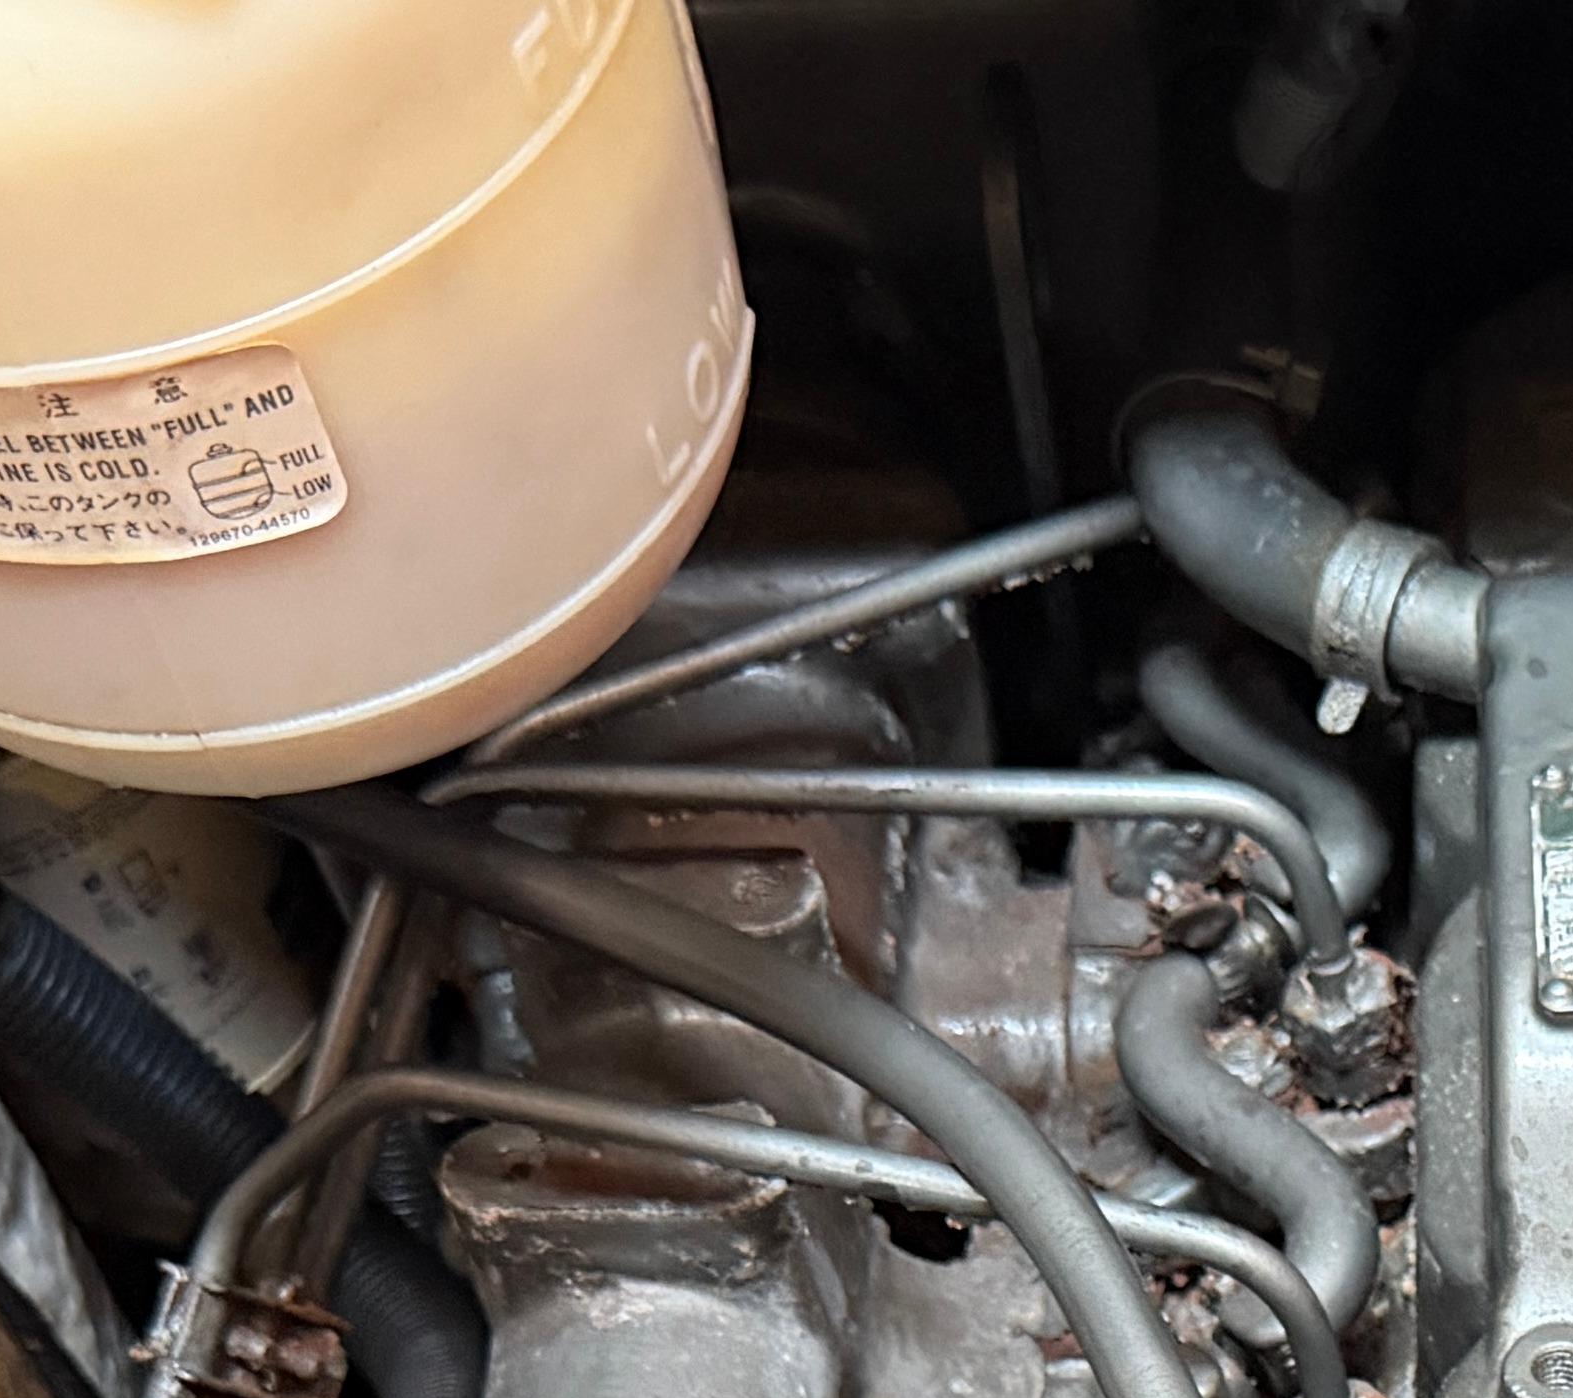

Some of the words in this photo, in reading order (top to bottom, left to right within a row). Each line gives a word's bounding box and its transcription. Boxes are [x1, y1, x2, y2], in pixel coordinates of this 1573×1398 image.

[26, 427, 147, 455] BETWEEN
[150, 403, 234, 441] "FULL"
[245, 383, 295, 419] AND
[44, 464, 74, 483] IS
[78, 456, 161, 482] COLD.
[279, 443, 325, 471] FULL
[292, 474, 334, 501] LOW
